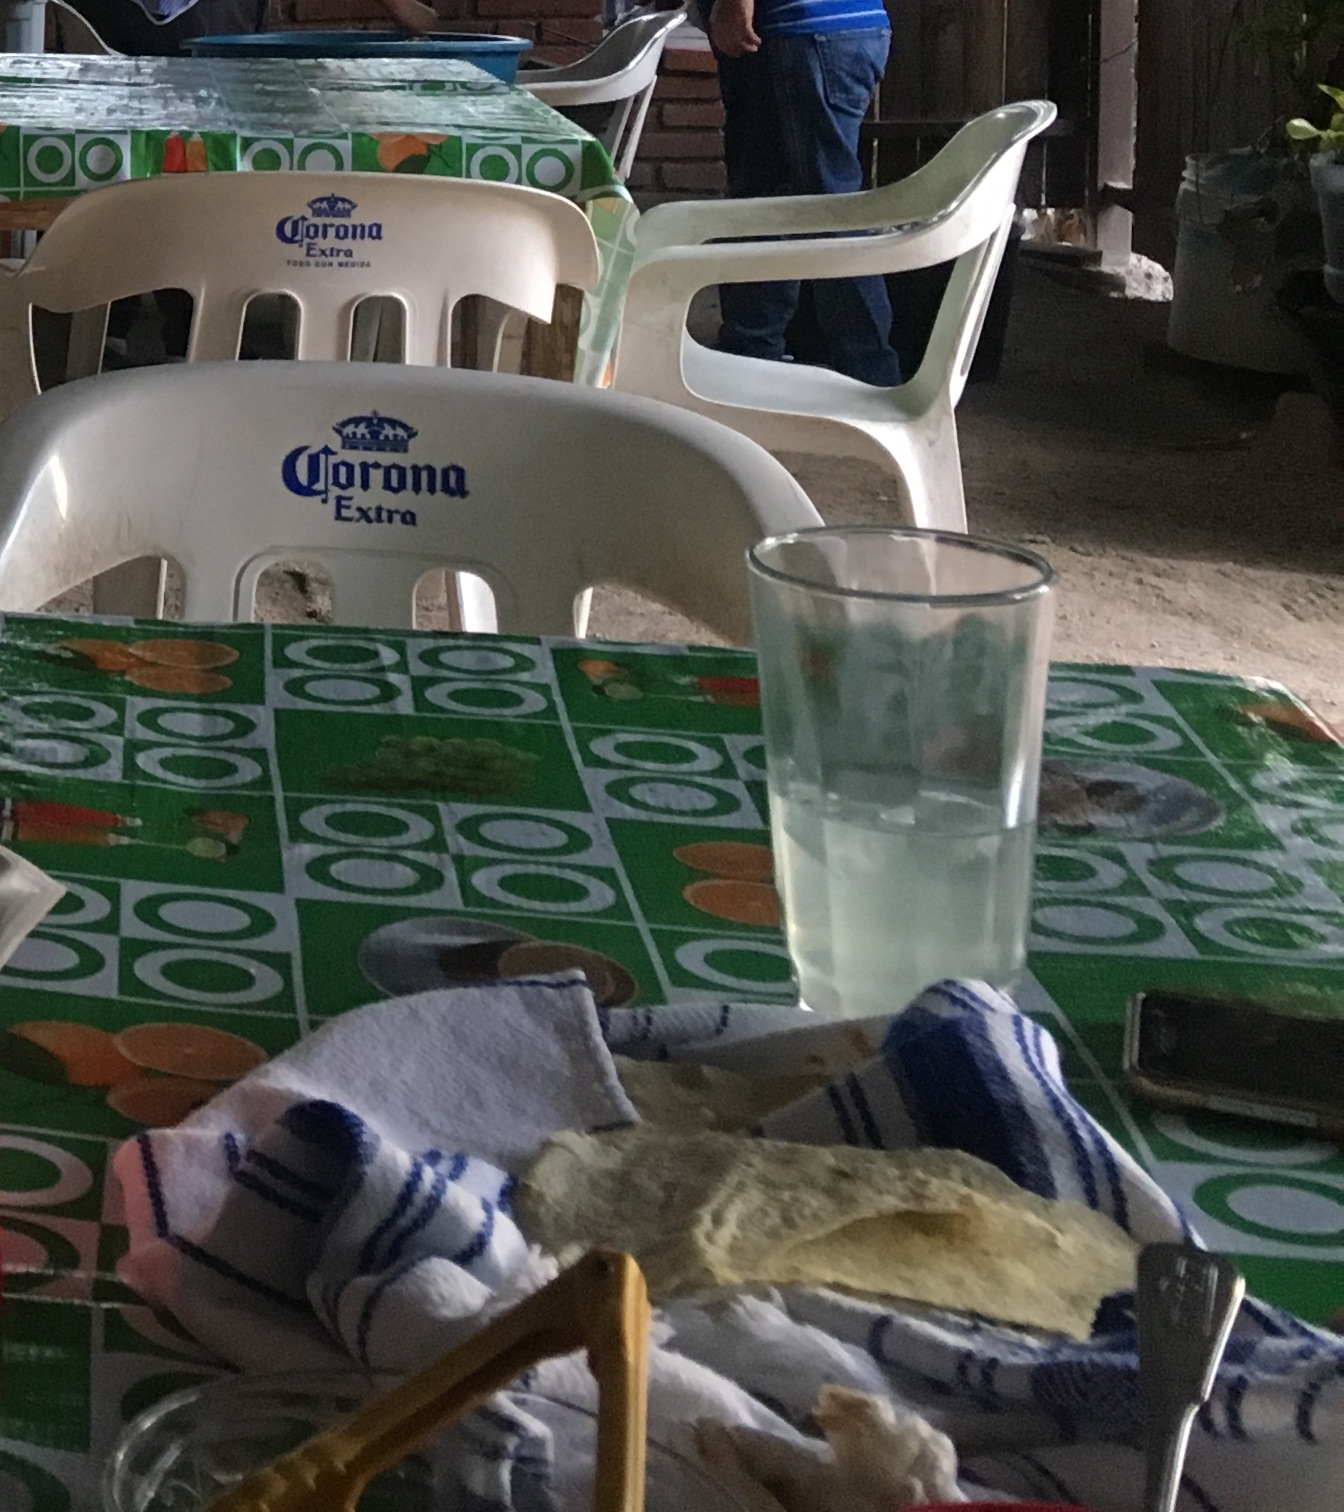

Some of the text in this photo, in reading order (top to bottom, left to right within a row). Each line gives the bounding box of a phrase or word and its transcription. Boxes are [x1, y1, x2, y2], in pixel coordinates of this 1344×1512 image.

[275, 215, 383, 248] Corona
[305, 242, 354, 257] Extra
[281, 444, 469, 504] Corona
[333, 496, 418, 527] Extra
